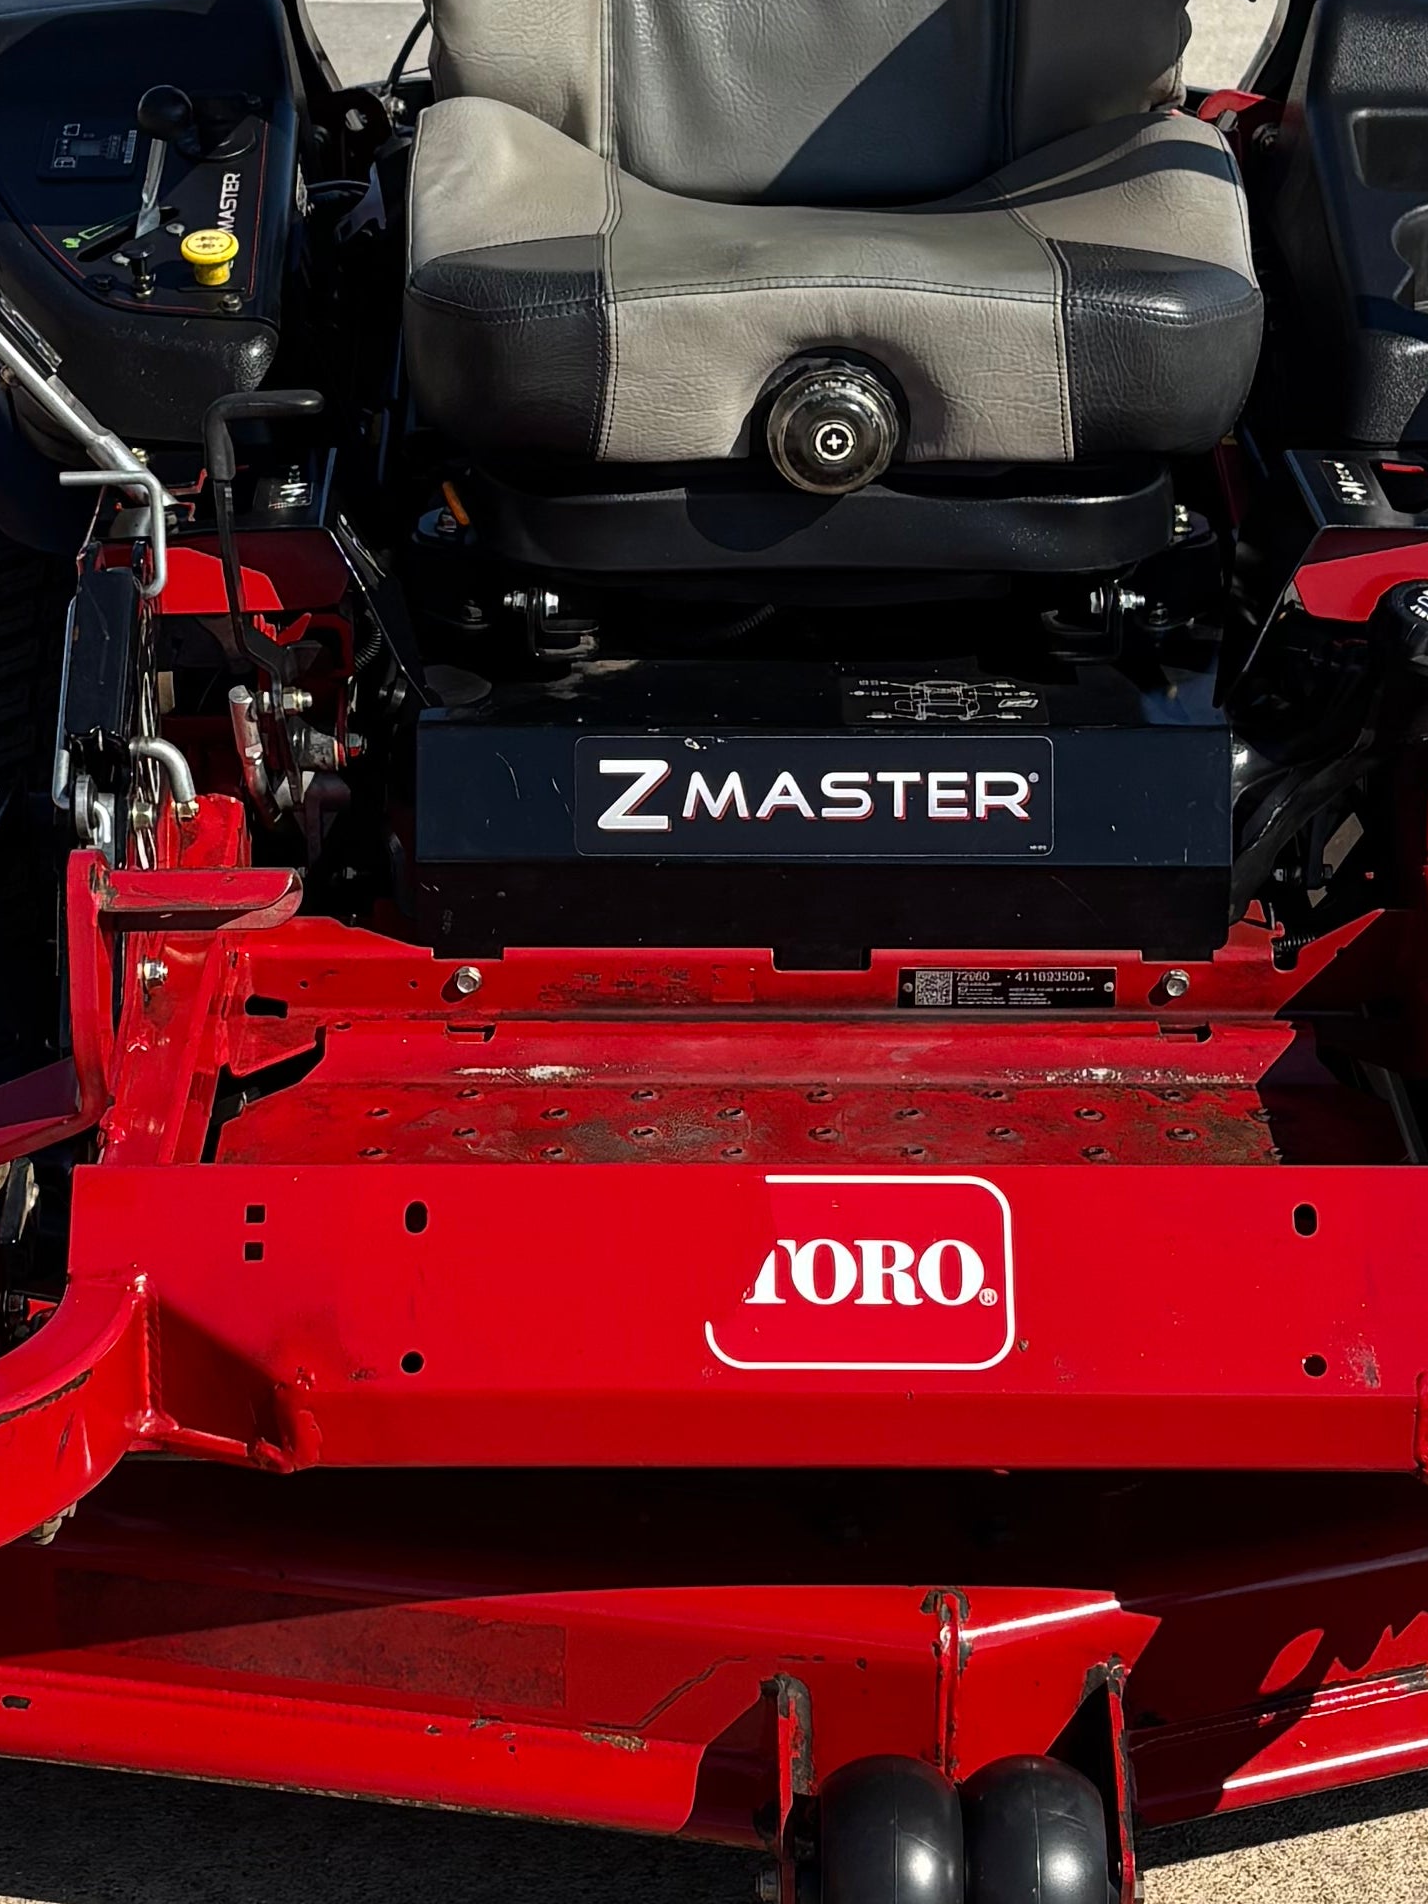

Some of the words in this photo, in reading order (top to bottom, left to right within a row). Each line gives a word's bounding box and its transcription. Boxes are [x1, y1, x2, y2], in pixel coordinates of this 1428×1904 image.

[217, 173, 241, 233] MASTER
[597, 759, 670, 831] Z
[682, 770, 1031, 820] MASTER
